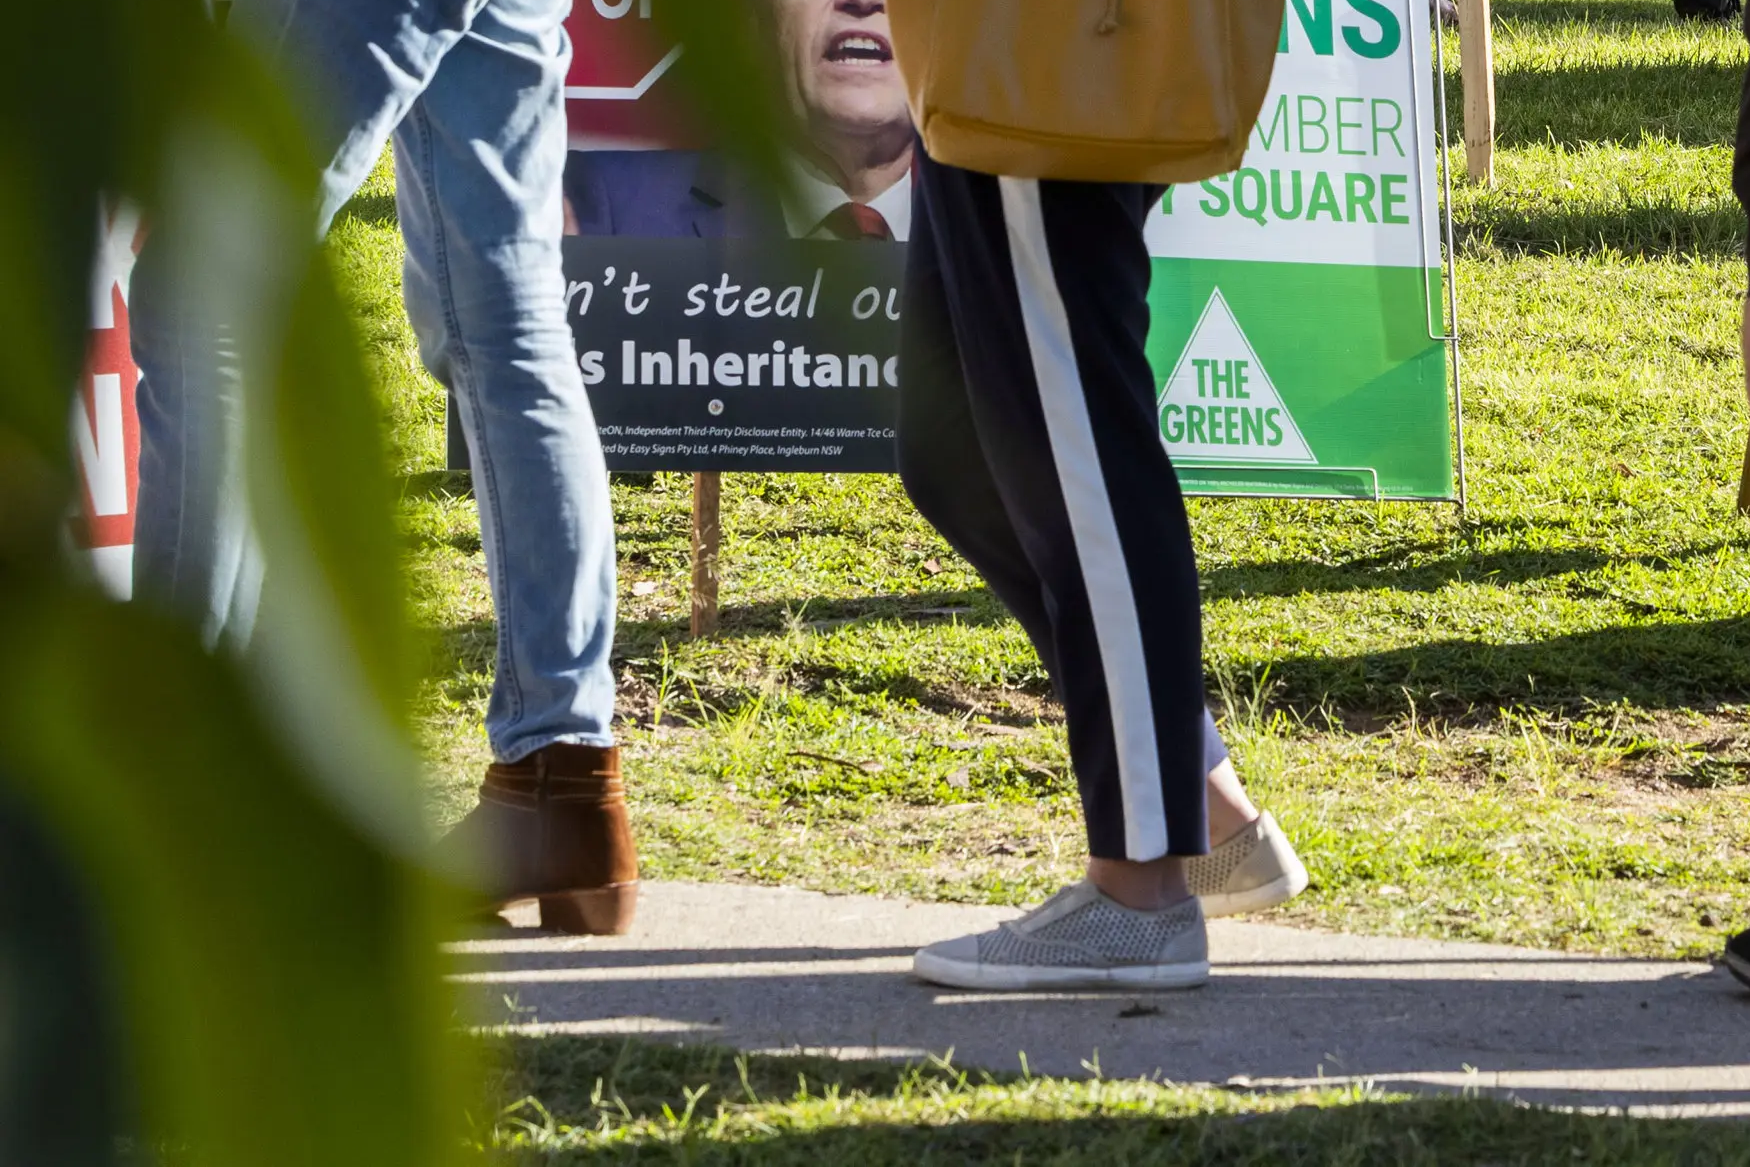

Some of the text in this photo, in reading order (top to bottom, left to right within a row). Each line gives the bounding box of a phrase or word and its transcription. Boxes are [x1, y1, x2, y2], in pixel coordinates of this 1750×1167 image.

[1199, 169, 1410, 227] SQUARE
[683, 268, 824, 319] steal
[1192, 358, 1251, 400] THE
[624, 425, 683, 438] Independent
[683, 426, 733, 439] Third-Party
[734, 426, 780, 438] Disclosure
[810, 427, 836, 439] 14/46
[866, 427, 882, 439] Tce
[1159, 404, 1284, 448] GREENS
[617, 443, 629, 456] by
[629, 443, 651, 456] Easy
[651, 443, 676, 457] Signs
[676, 444, 693, 457] Pty
[710, 445, 718, 454] 4
[776, 445, 820, 458] Ingleburn
[820, 445, 844, 455] NSW
